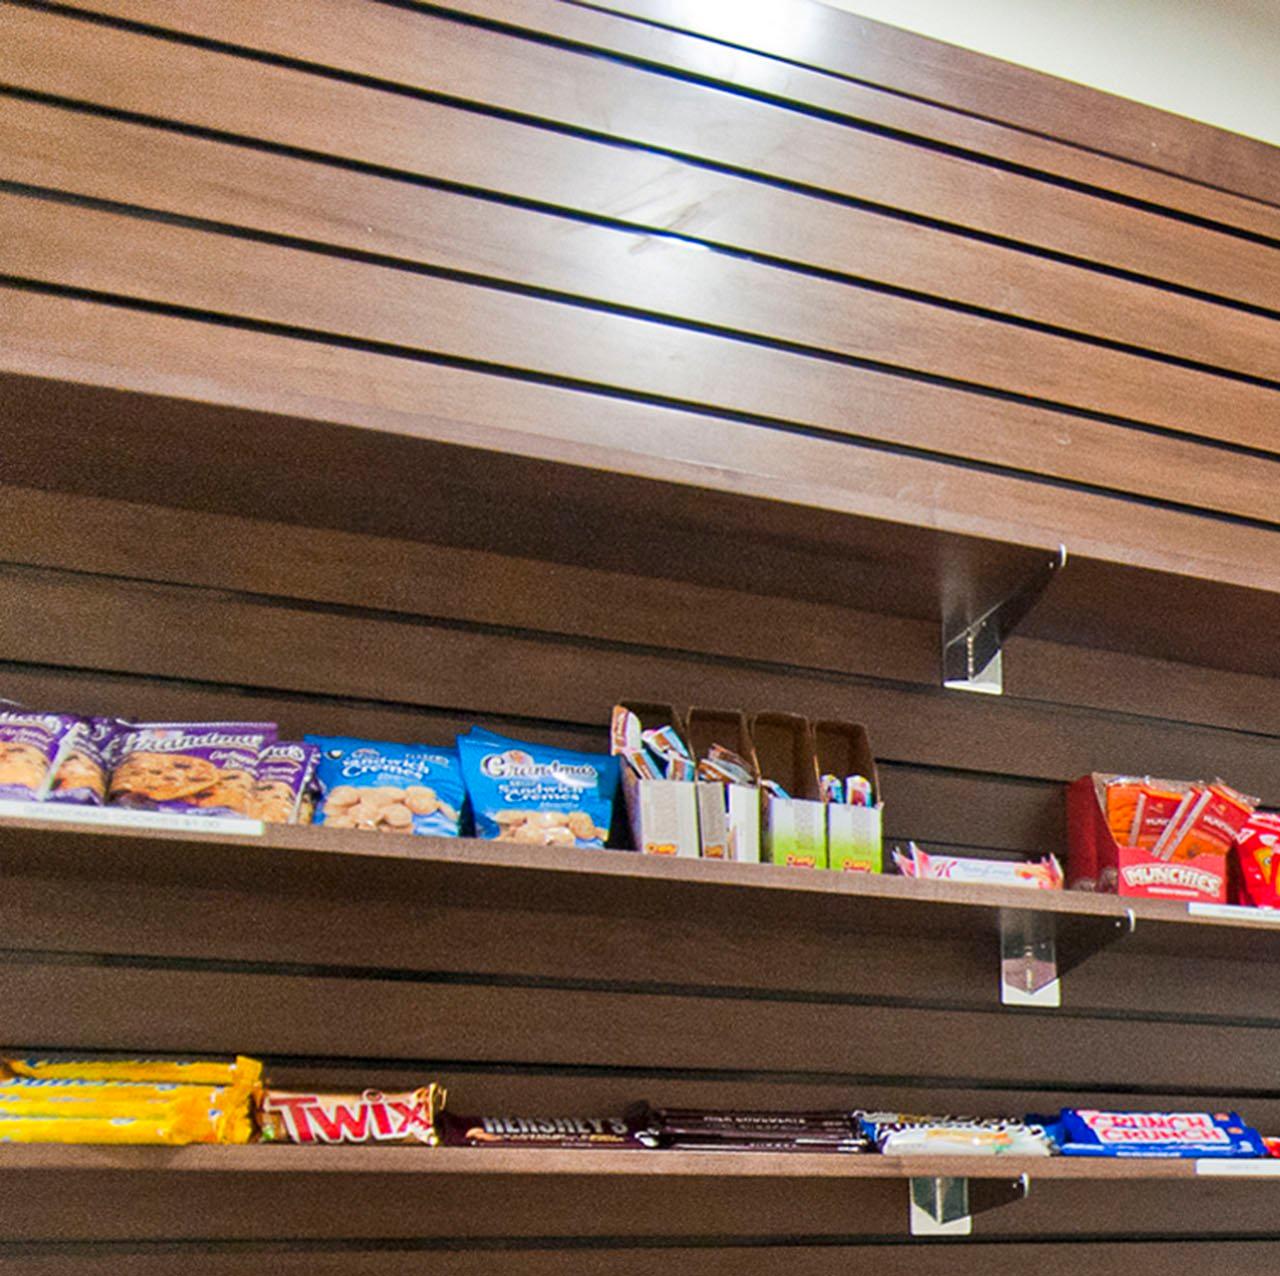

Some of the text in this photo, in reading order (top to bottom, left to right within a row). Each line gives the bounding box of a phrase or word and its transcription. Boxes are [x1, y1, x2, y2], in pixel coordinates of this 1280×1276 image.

[1123, 864, 1222, 896] MUNCHIES
[1089, 1114, 1208, 1129] CRUNCH
[1102, 1128, 1222, 1141] CRUNCH
